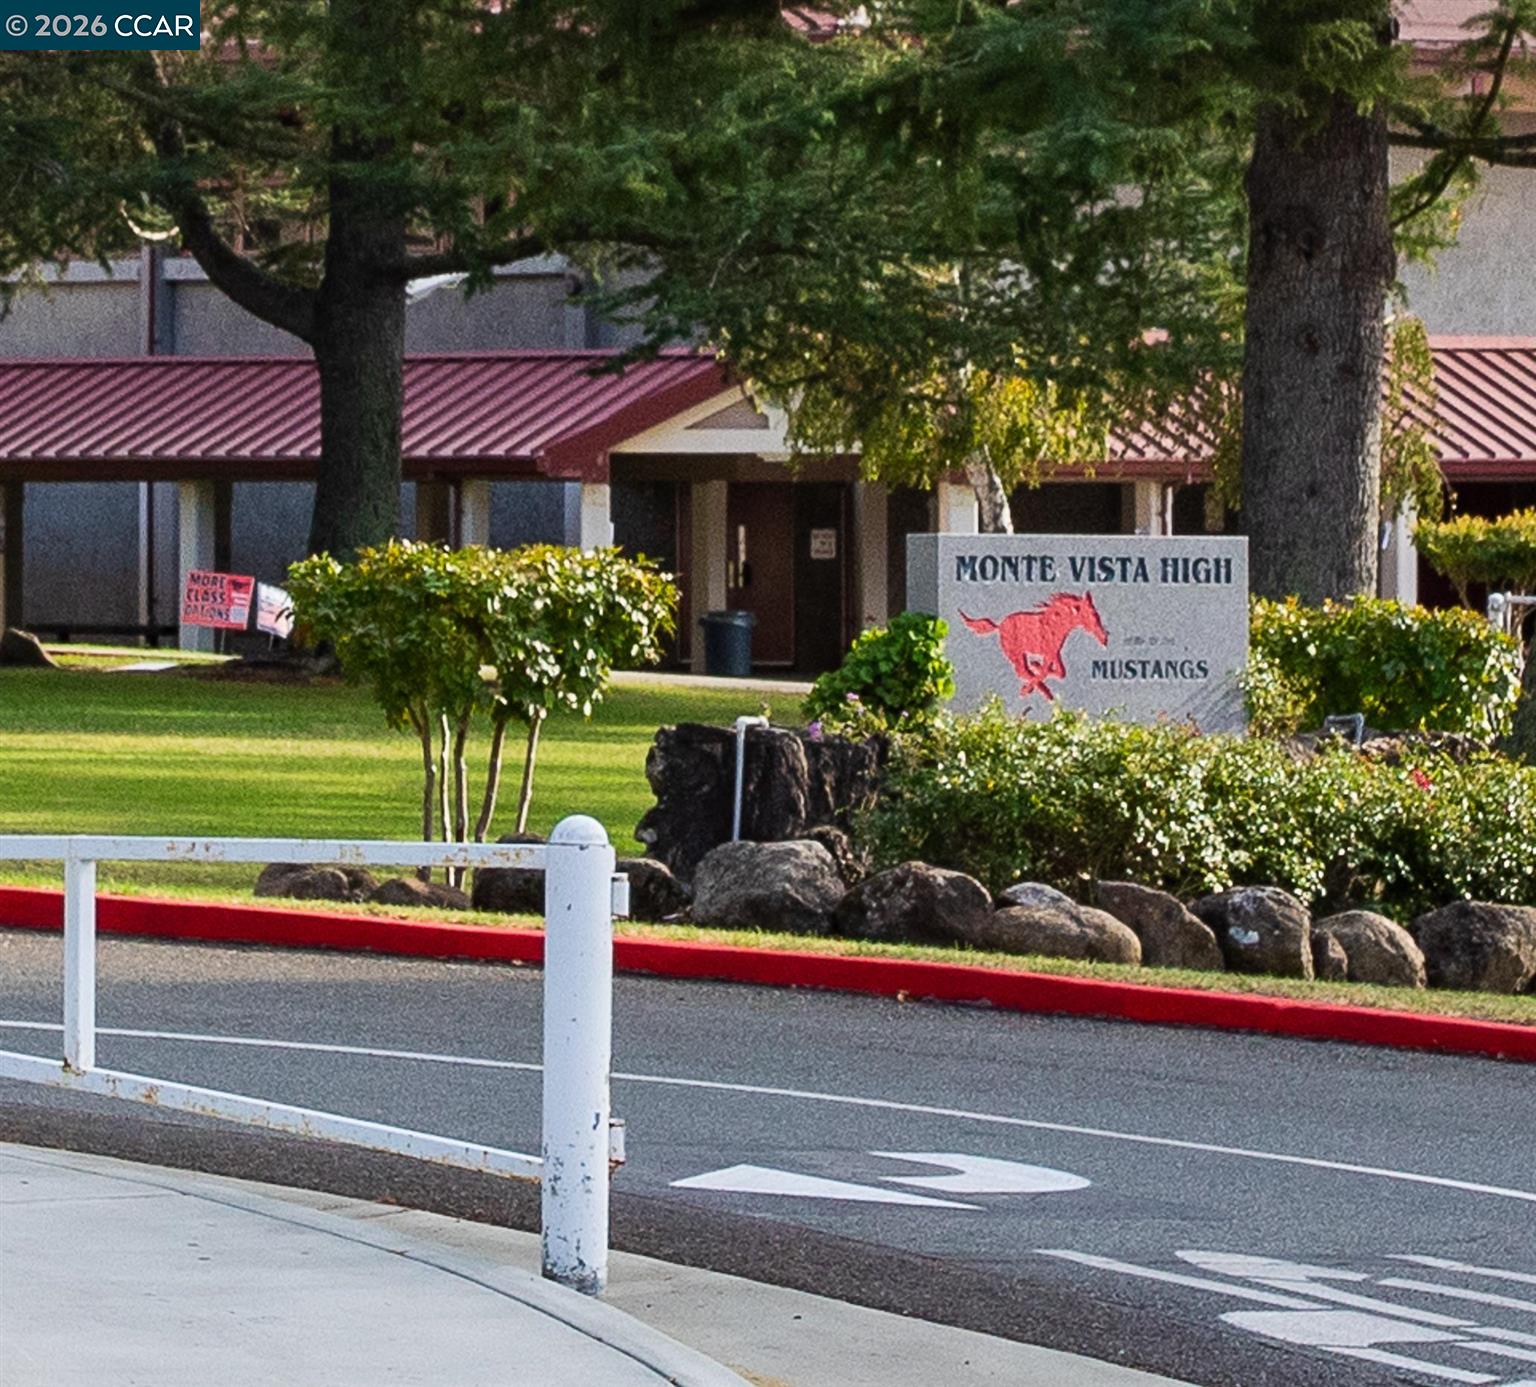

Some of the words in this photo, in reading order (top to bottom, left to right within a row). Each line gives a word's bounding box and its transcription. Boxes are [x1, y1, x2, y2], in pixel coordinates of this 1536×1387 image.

[955, 554, 1056, 583] MONTE
[1068, 556, 1150, 584] VISTA
[1160, 557, 1233, 584] HIGH
[190, 573, 226, 589] MORE
[186, 588, 225, 604] CLASS
[184, 604, 230, 621] OPTIONS
[1091, 659, 1209, 681] MUSTANGS
